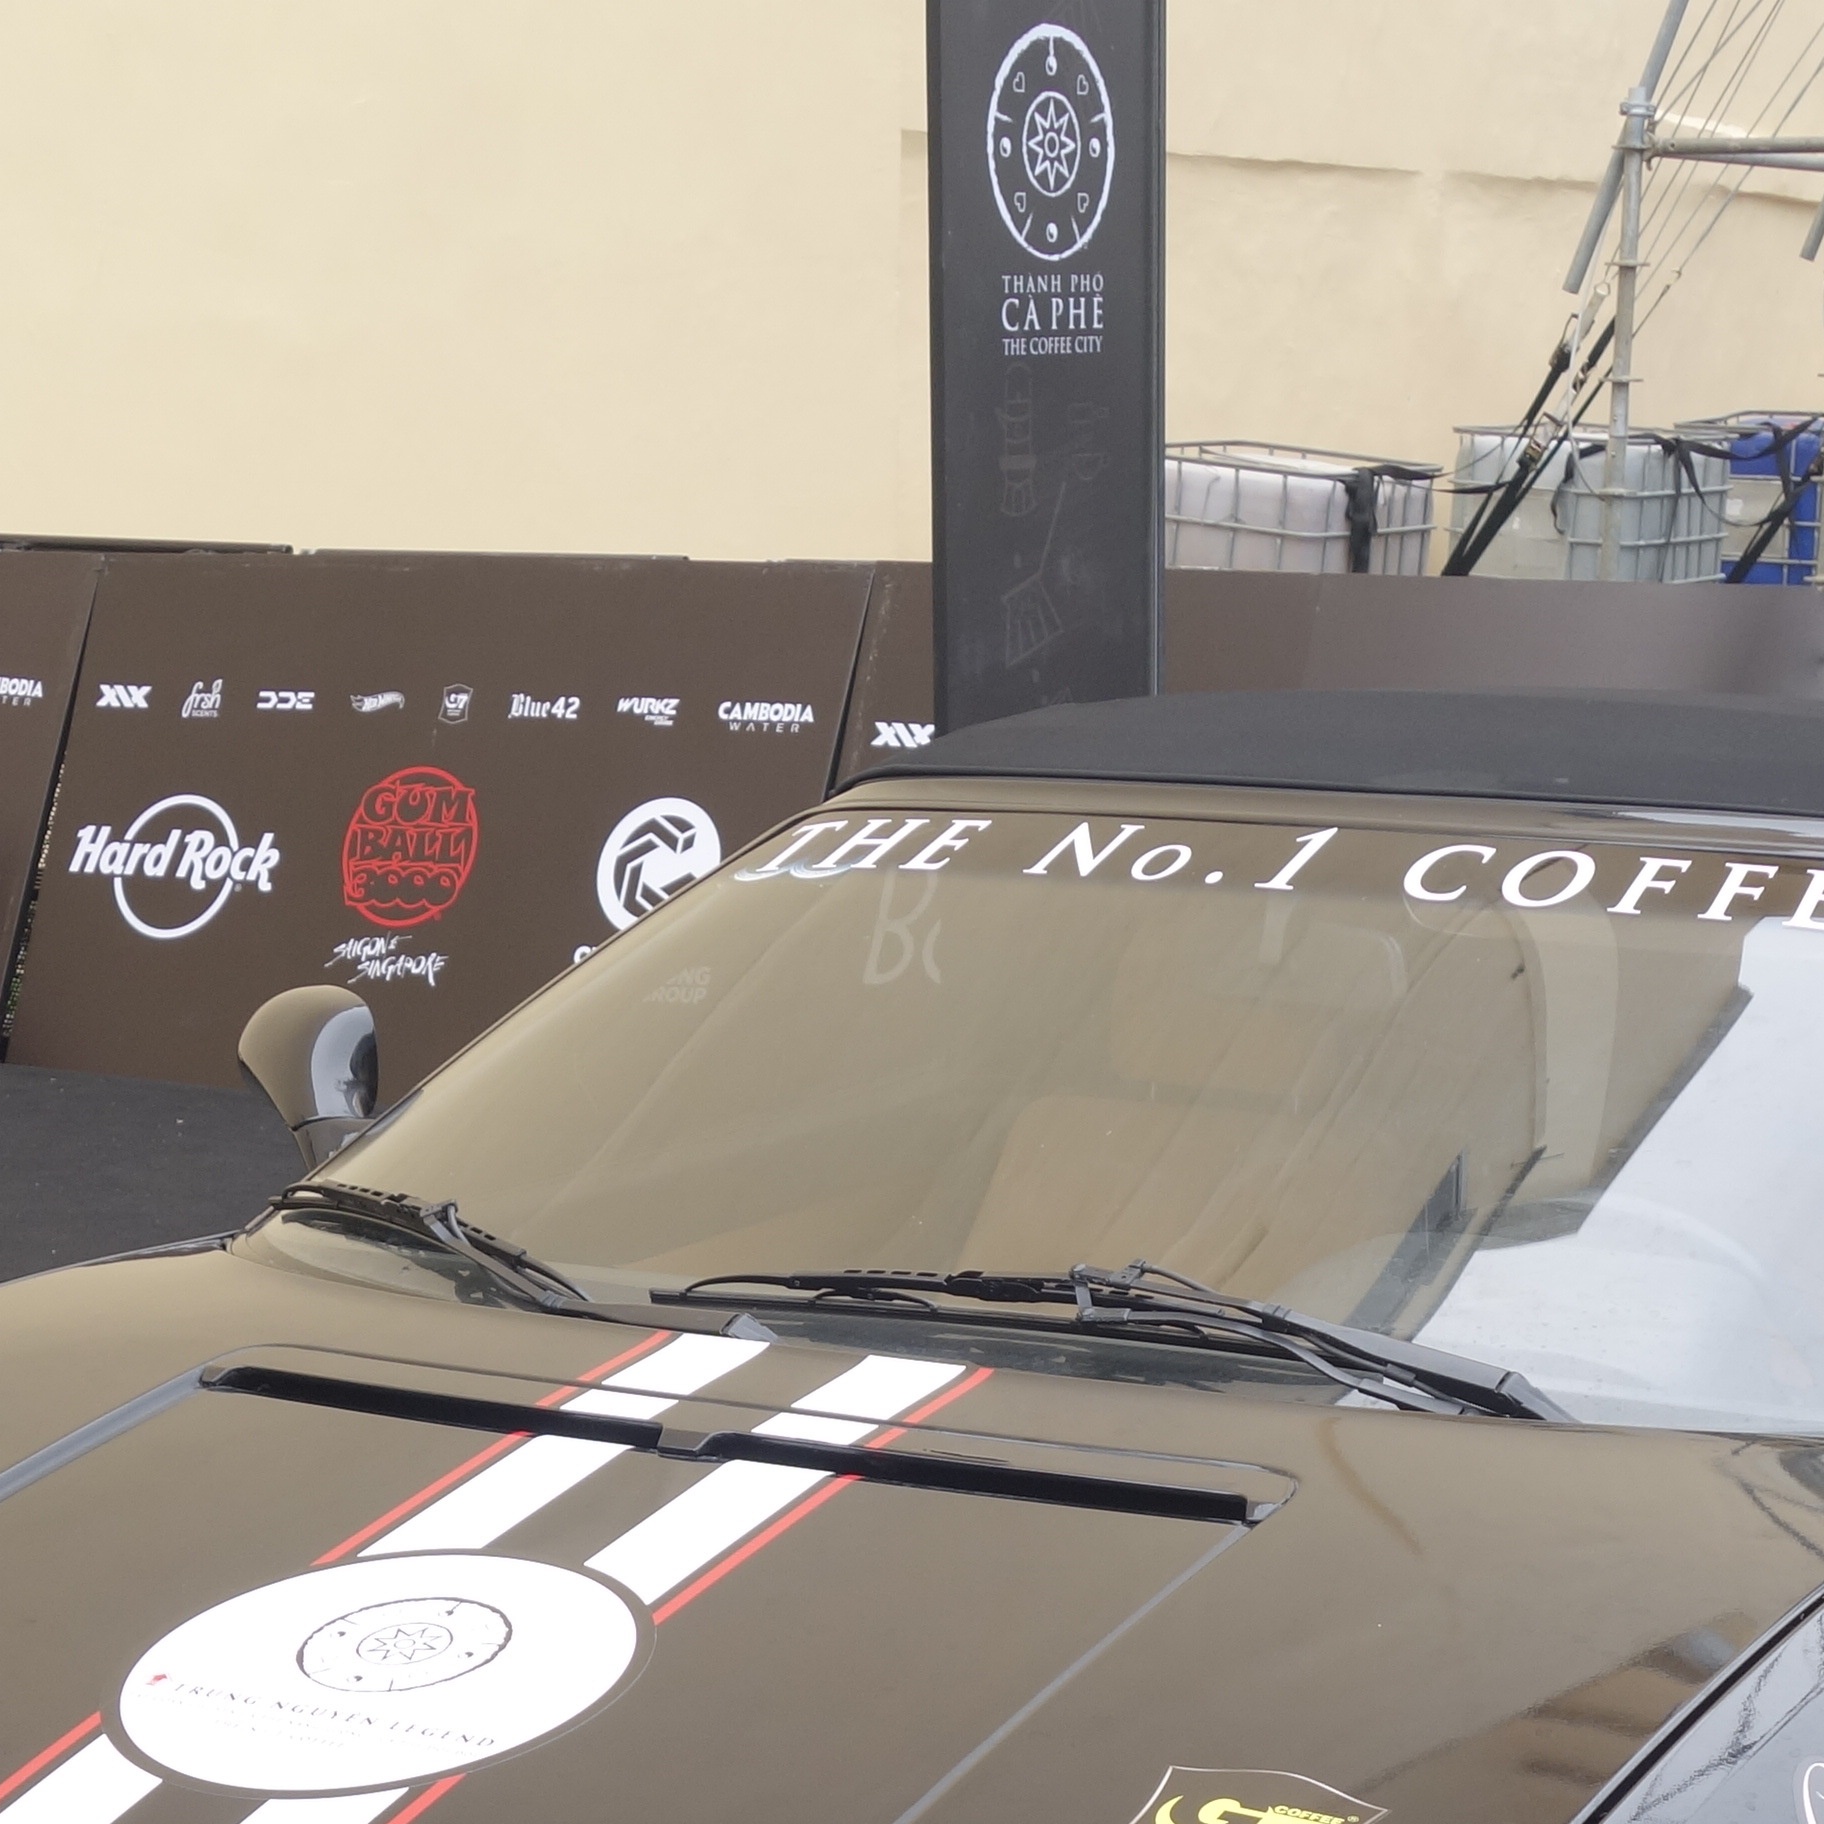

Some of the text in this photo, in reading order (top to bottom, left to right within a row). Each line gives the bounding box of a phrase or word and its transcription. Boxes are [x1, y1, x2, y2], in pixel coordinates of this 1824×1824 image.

[1001, 294, 1042, 332] CÀ
[1002, 335, 1103, 356] THE COFFEE CITY
[717, 701, 815, 723] CAMBODIA
[728, 721, 801, 734] WATER
[68, 825, 281, 893] Hard Rock
[755, 817, 993, 872] THE
